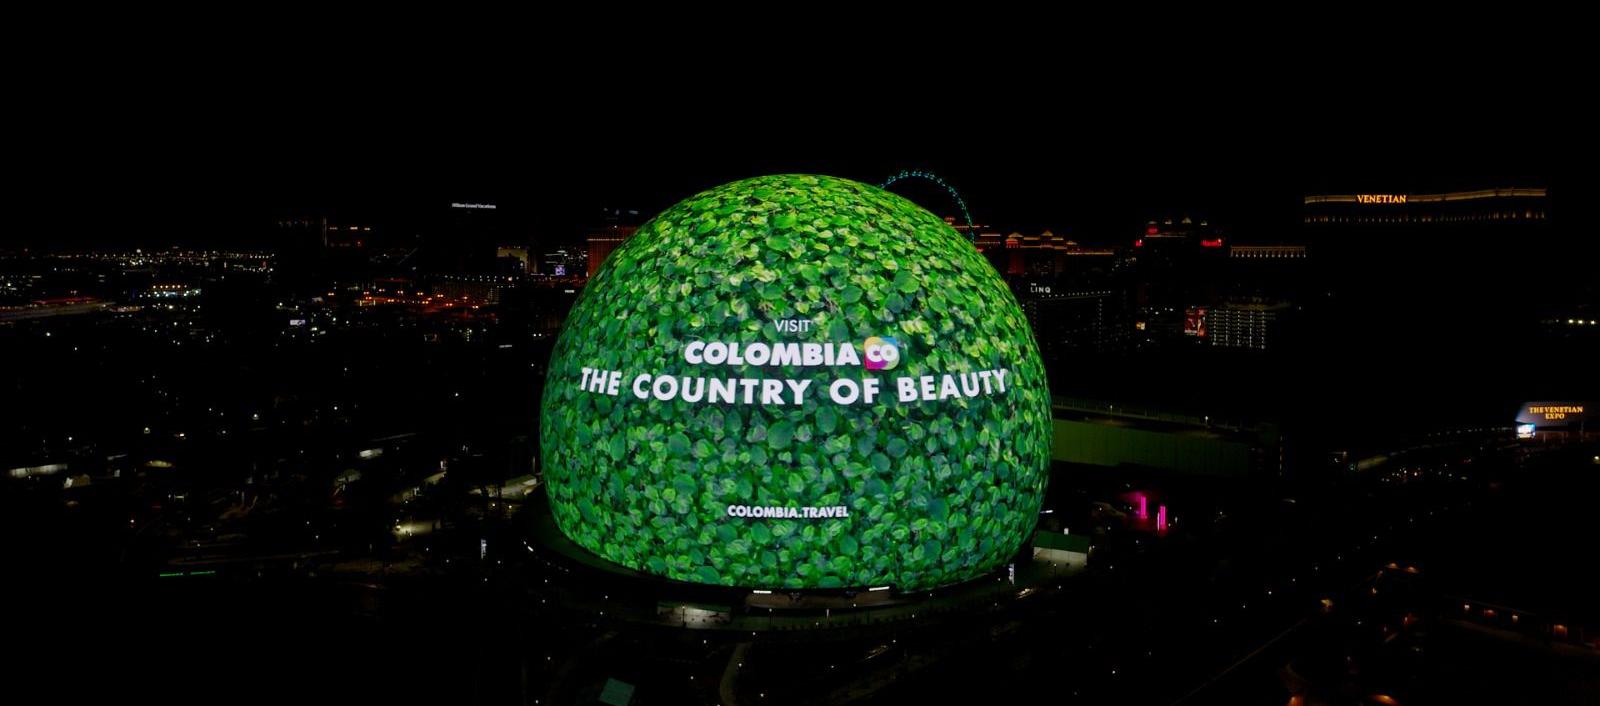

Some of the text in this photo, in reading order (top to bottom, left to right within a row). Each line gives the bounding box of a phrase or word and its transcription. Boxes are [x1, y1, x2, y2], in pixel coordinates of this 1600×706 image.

[1357, 194, 1406, 203] VENETIAN
[774, 320, 811, 332] VISIT
[685, 341, 899, 366] COLOMBIA CO
[580, 367, 1008, 405] THE COUNTRY OF BEAUTY
[727, 505, 849, 518] COLOMBIA.TRAVEL
